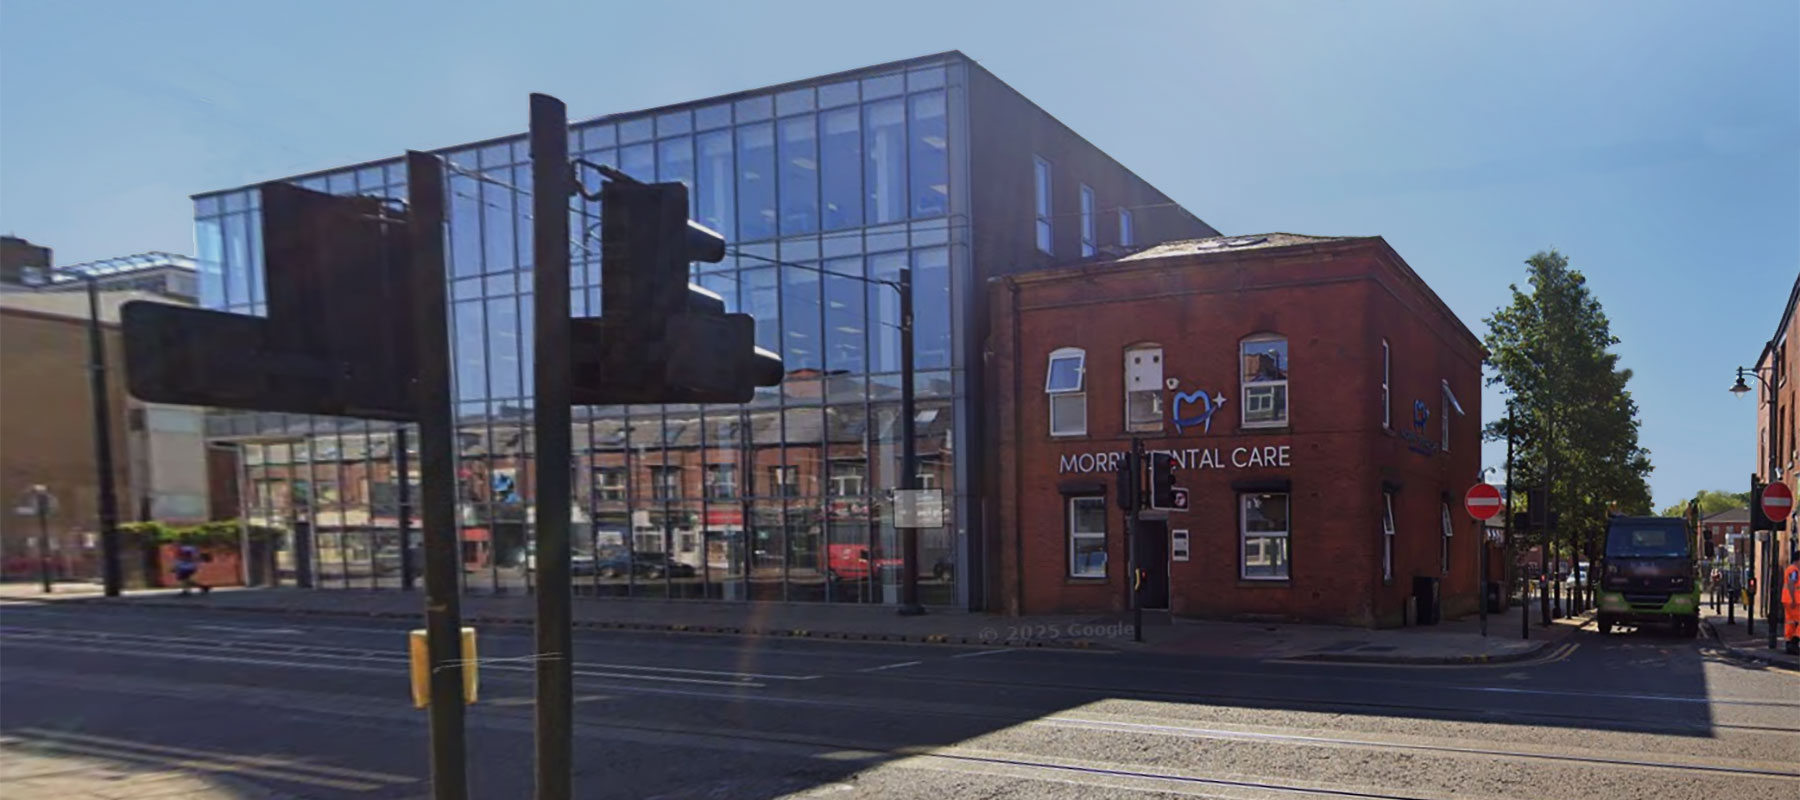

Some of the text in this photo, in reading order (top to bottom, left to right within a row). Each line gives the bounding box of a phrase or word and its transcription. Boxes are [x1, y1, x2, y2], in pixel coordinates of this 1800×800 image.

[1059, 446, 1291, 473] MORR NTAL CARE
